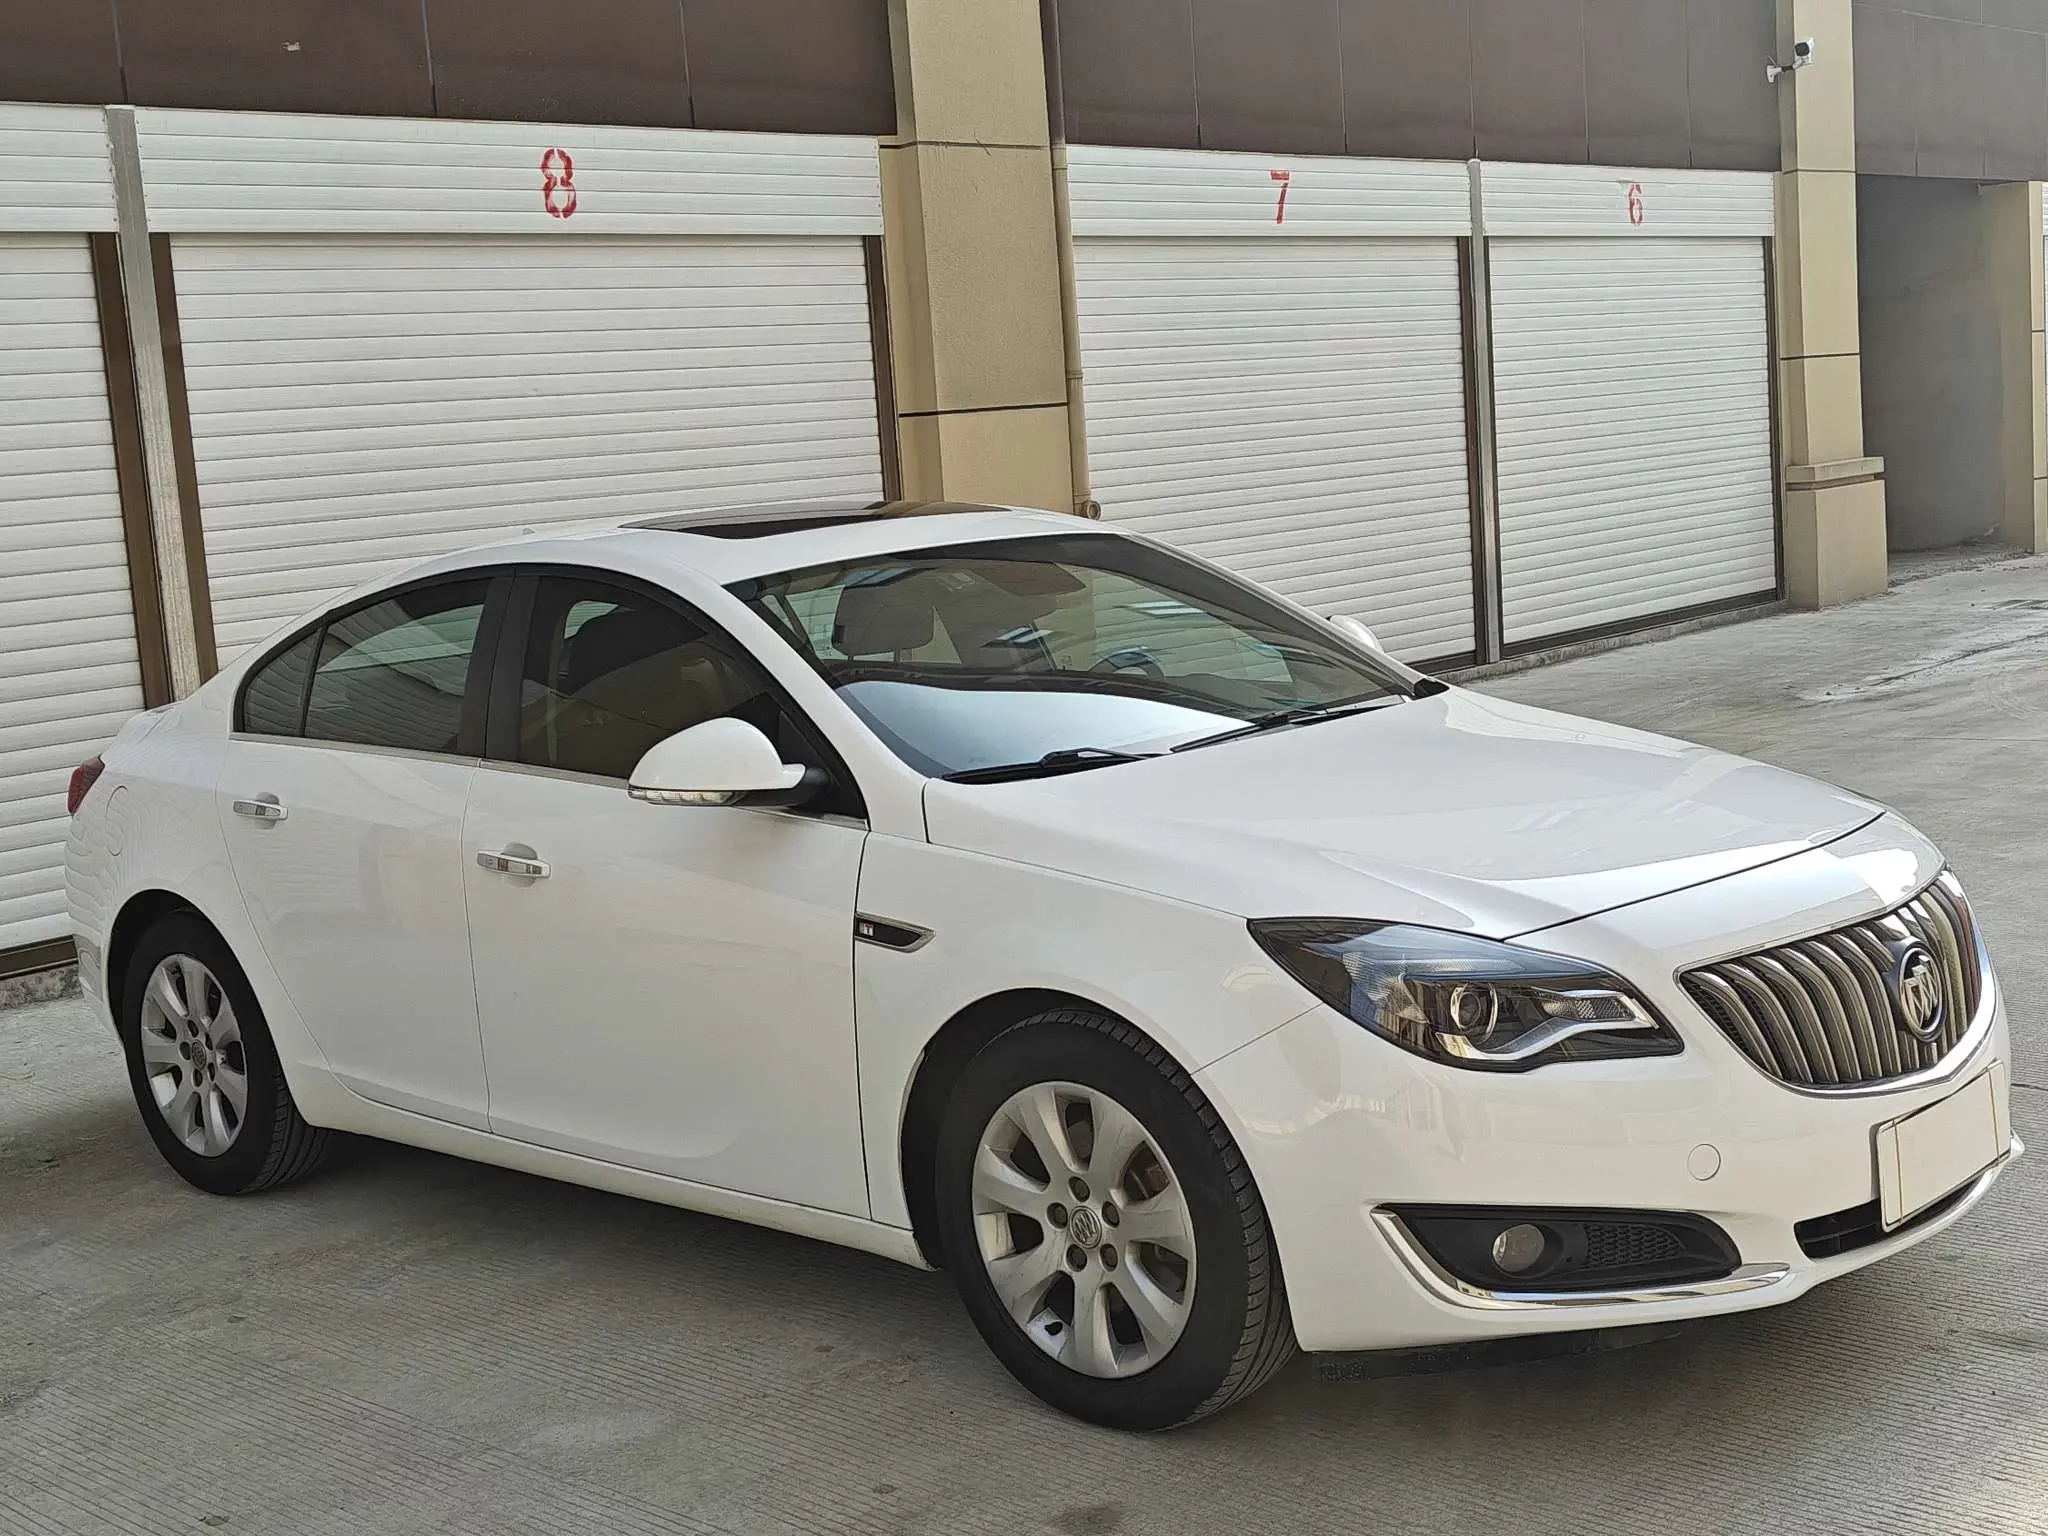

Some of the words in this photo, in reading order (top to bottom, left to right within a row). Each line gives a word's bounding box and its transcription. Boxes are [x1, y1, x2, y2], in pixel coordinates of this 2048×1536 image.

[541, 148, 577, 218] 8
[1270, 170, 1290, 224] 7
[1628, 183, 1643, 226] 6
